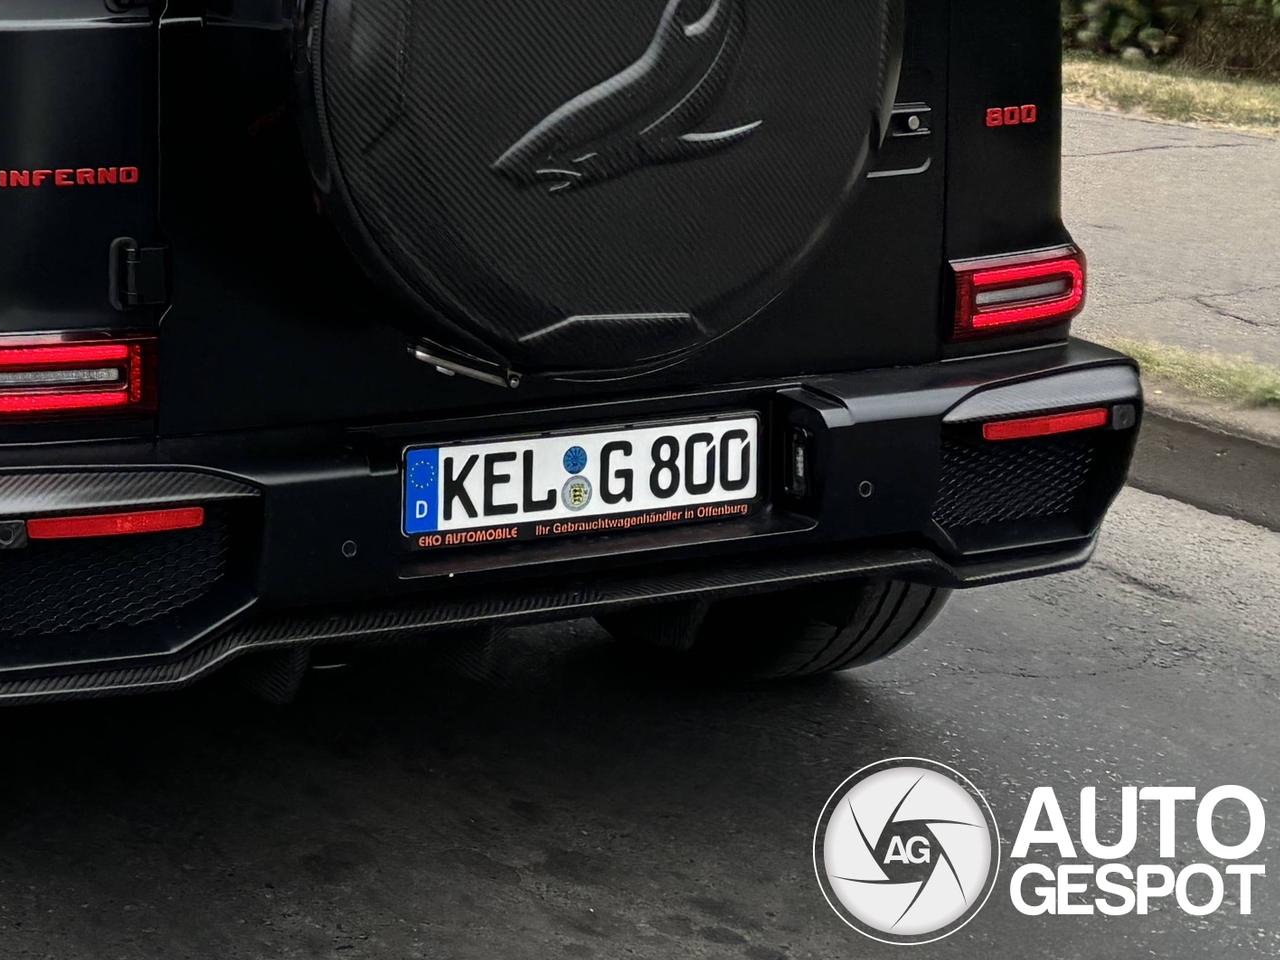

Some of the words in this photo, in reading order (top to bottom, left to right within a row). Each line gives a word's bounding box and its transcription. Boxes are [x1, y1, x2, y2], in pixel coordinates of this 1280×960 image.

[985, 104, 1037, 128] 800
[443, 449, 557, 521] KEL
[600, 440, 634, 504] G
[649, 429, 751, 499] 800
[415, 500, 428, 519] D
[535, 523, 550, 536] Ihr
[553, 509, 683, 534] Gebrauchtwagenhändler
[684, 507, 694, 520] in
[697, 503, 748, 522] Offenburg
[418, 535, 442, 547] EKO
[445, 527, 519, 545] AUTOMOBILE
